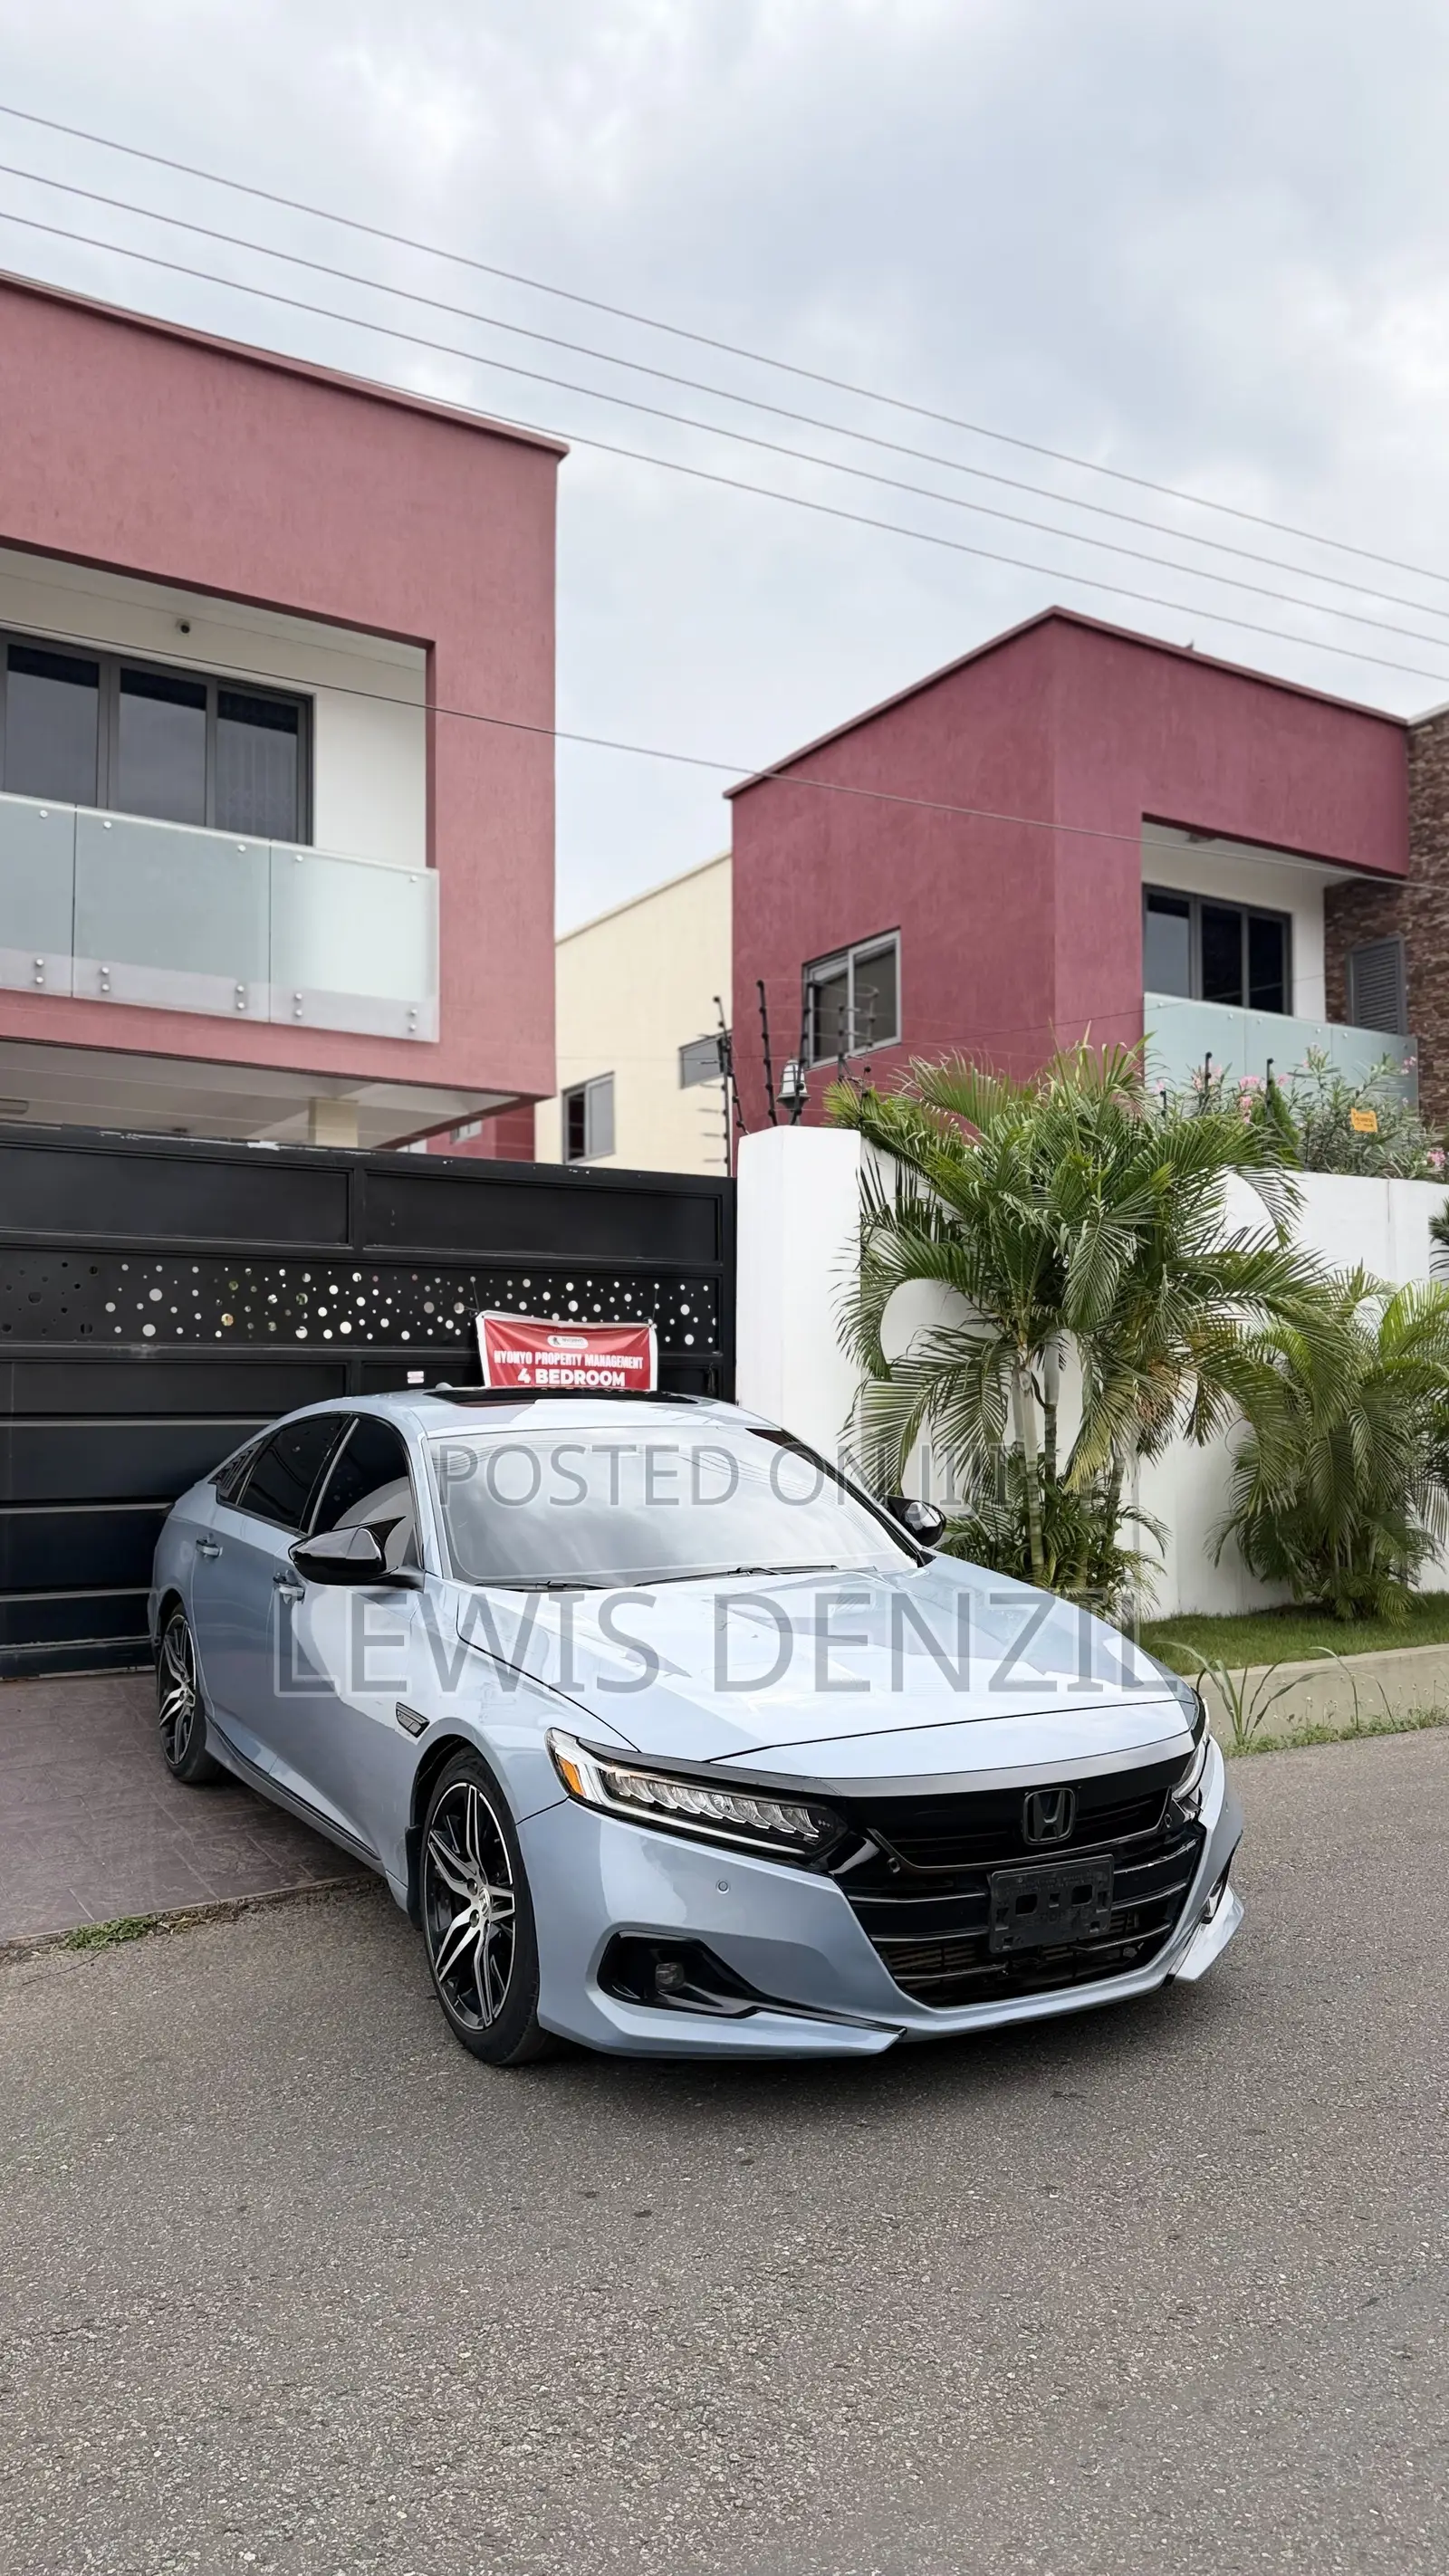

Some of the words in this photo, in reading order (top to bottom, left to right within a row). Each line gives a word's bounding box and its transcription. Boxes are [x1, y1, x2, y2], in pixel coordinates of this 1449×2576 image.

[494, 1350, 533, 1365] NYONYO
[535, 1351, 582, 1366] PROPERTY
[584, 1354, 644, 1370] MANAGEMENT
[517, 1367, 532, 1384] 4
[535, 1368, 626, 1387] BEDROOM
